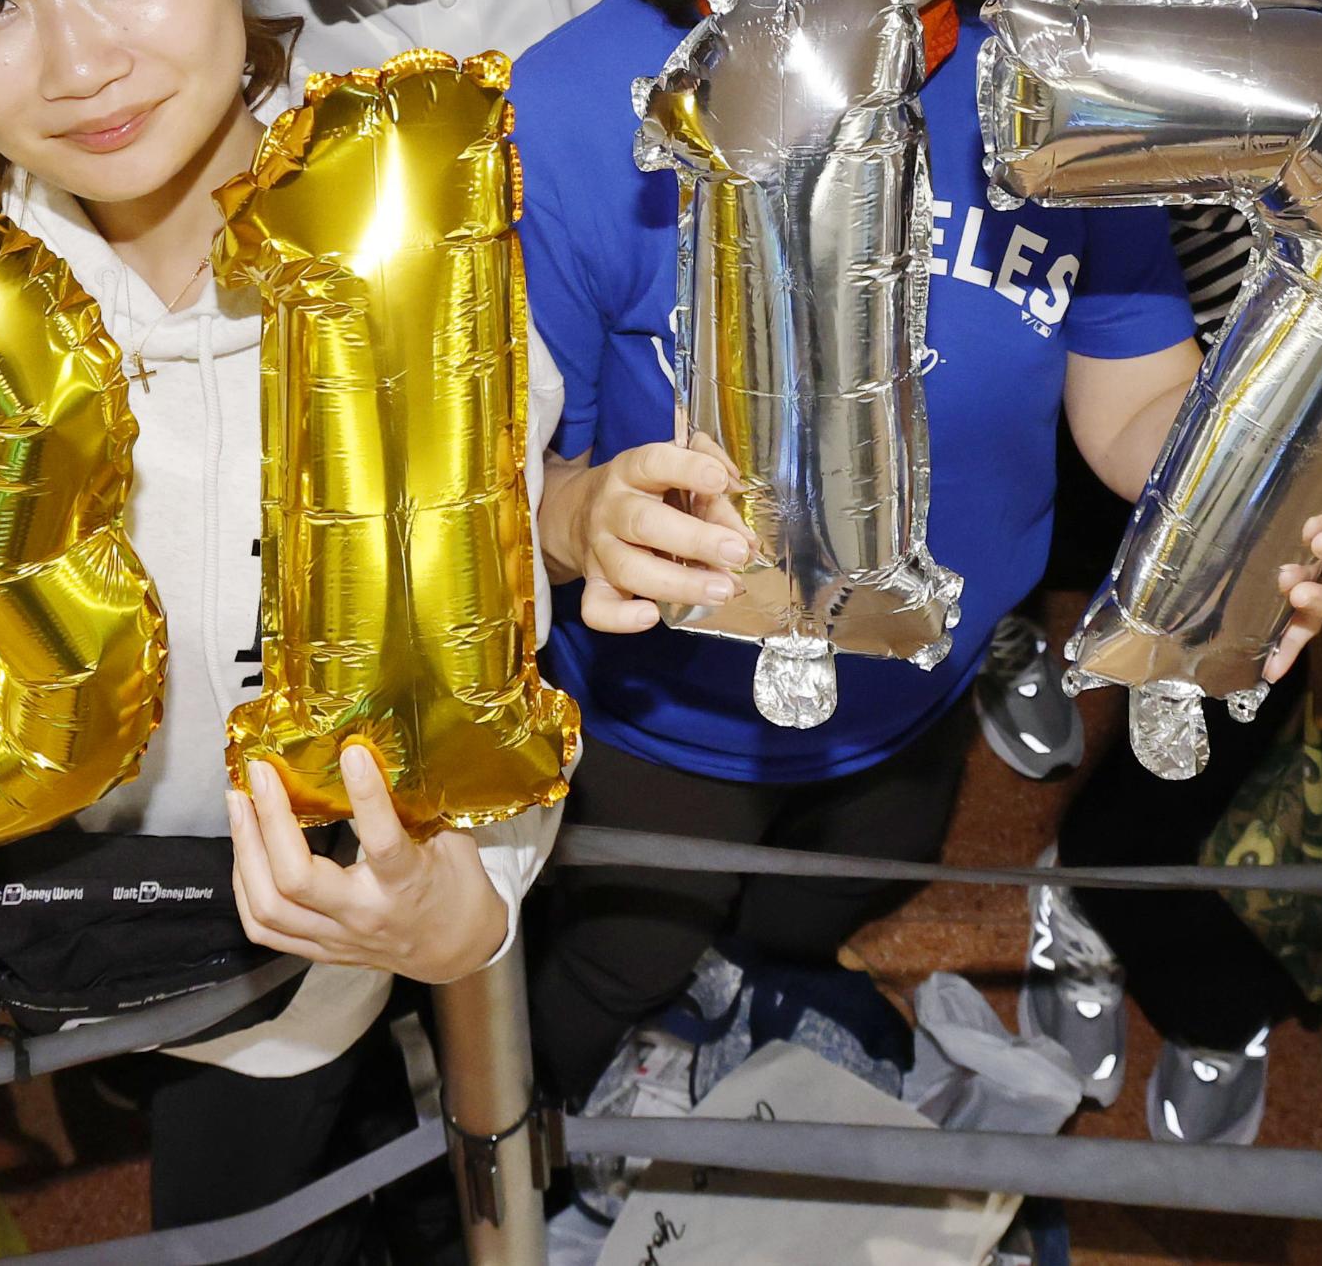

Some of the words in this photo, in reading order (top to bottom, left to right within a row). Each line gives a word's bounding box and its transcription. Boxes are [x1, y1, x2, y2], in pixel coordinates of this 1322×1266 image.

[53, 888, 84, 901] World
[113, 887, 138, 901] Walt
[138, 881, 184, 903] Disney
[185, 887, 214, 900] World
